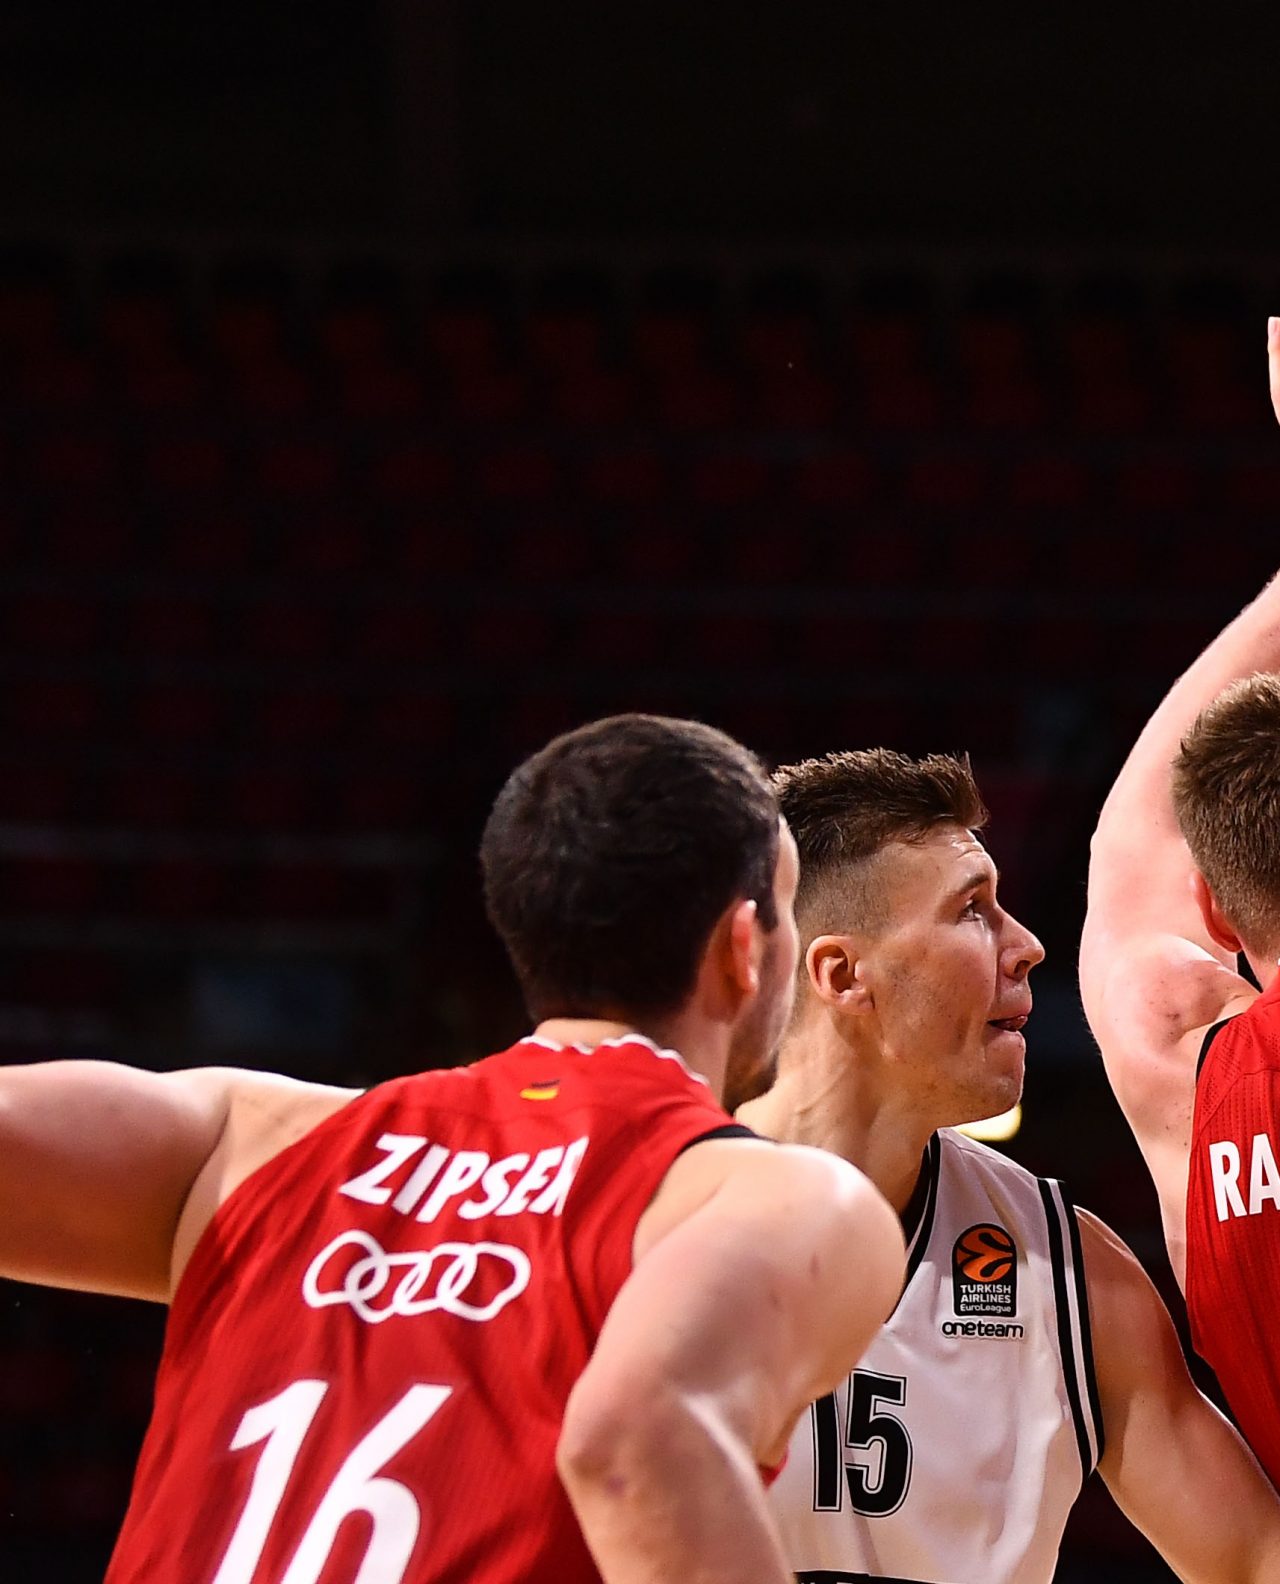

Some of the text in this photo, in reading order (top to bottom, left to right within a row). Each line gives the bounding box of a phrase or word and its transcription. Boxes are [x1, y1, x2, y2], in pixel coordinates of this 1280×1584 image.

[960, 1284, 1012, 1294] TURKISH
[960, 1294, 1012, 1304] AIRLINES
[960, 1303, 1012, 1314] EuroLeague
[811, 1369, 914, 1518] 15
[213, 1379, 453, 1584] 16
